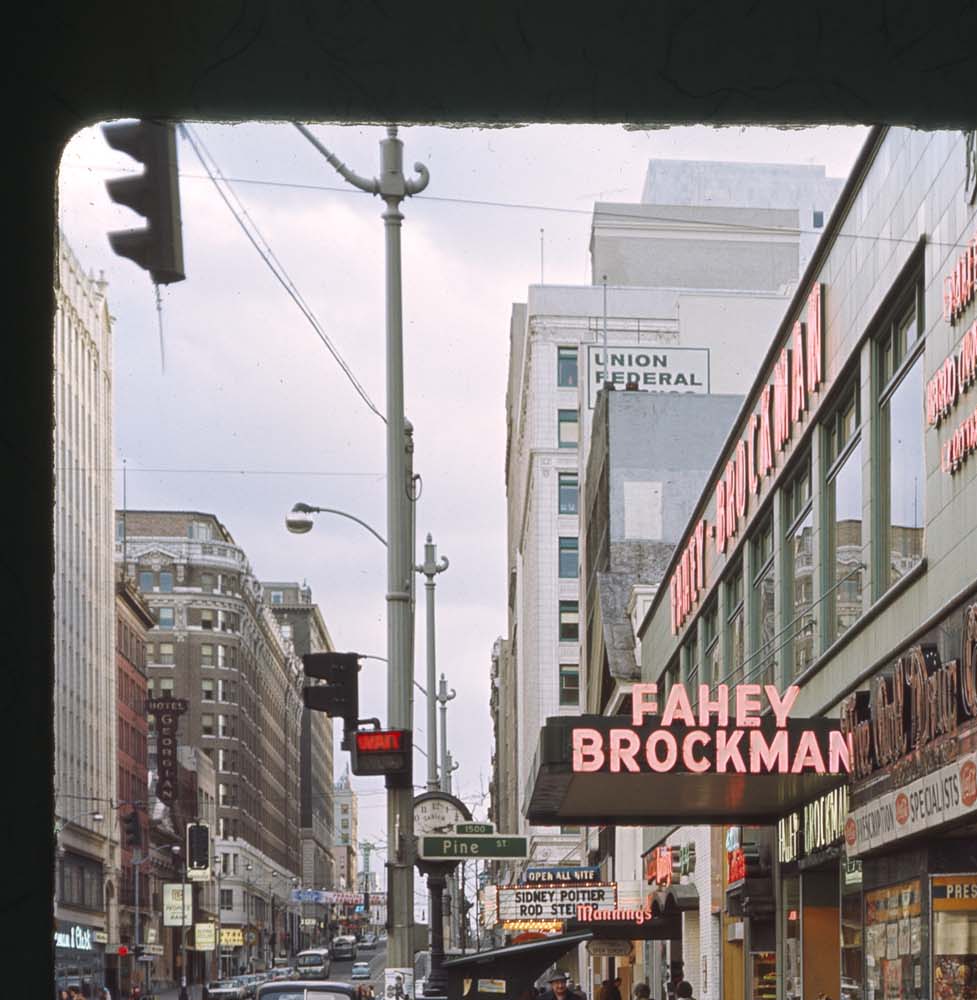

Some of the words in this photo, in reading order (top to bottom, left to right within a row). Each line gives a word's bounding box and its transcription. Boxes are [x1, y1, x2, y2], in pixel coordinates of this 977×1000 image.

[594, 353, 668, 368] UNION
[595, 371, 703, 386] FEDERAL
[149, 701, 185, 711] HOTEL
[631, 683, 801, 727] FAHEY
[357, 733, 401, 751] WAIT
[160, 713, 173, 801] GEORGIAN
[571, 727, 854, 774] BROCKMAN
[908, 775, 960, 822] SPECIALISTS
[465, 825, 486, 833] 1500
[443, 840, 479, 854] Pine
[528, 872, 553, 881] OPEN
[556, 871, 571, 881] ALL
[515, 891, 555, 903] SIDNEY
[560, 890, 605, 902] POITIER
[520, 905, 543, 917] ROD
